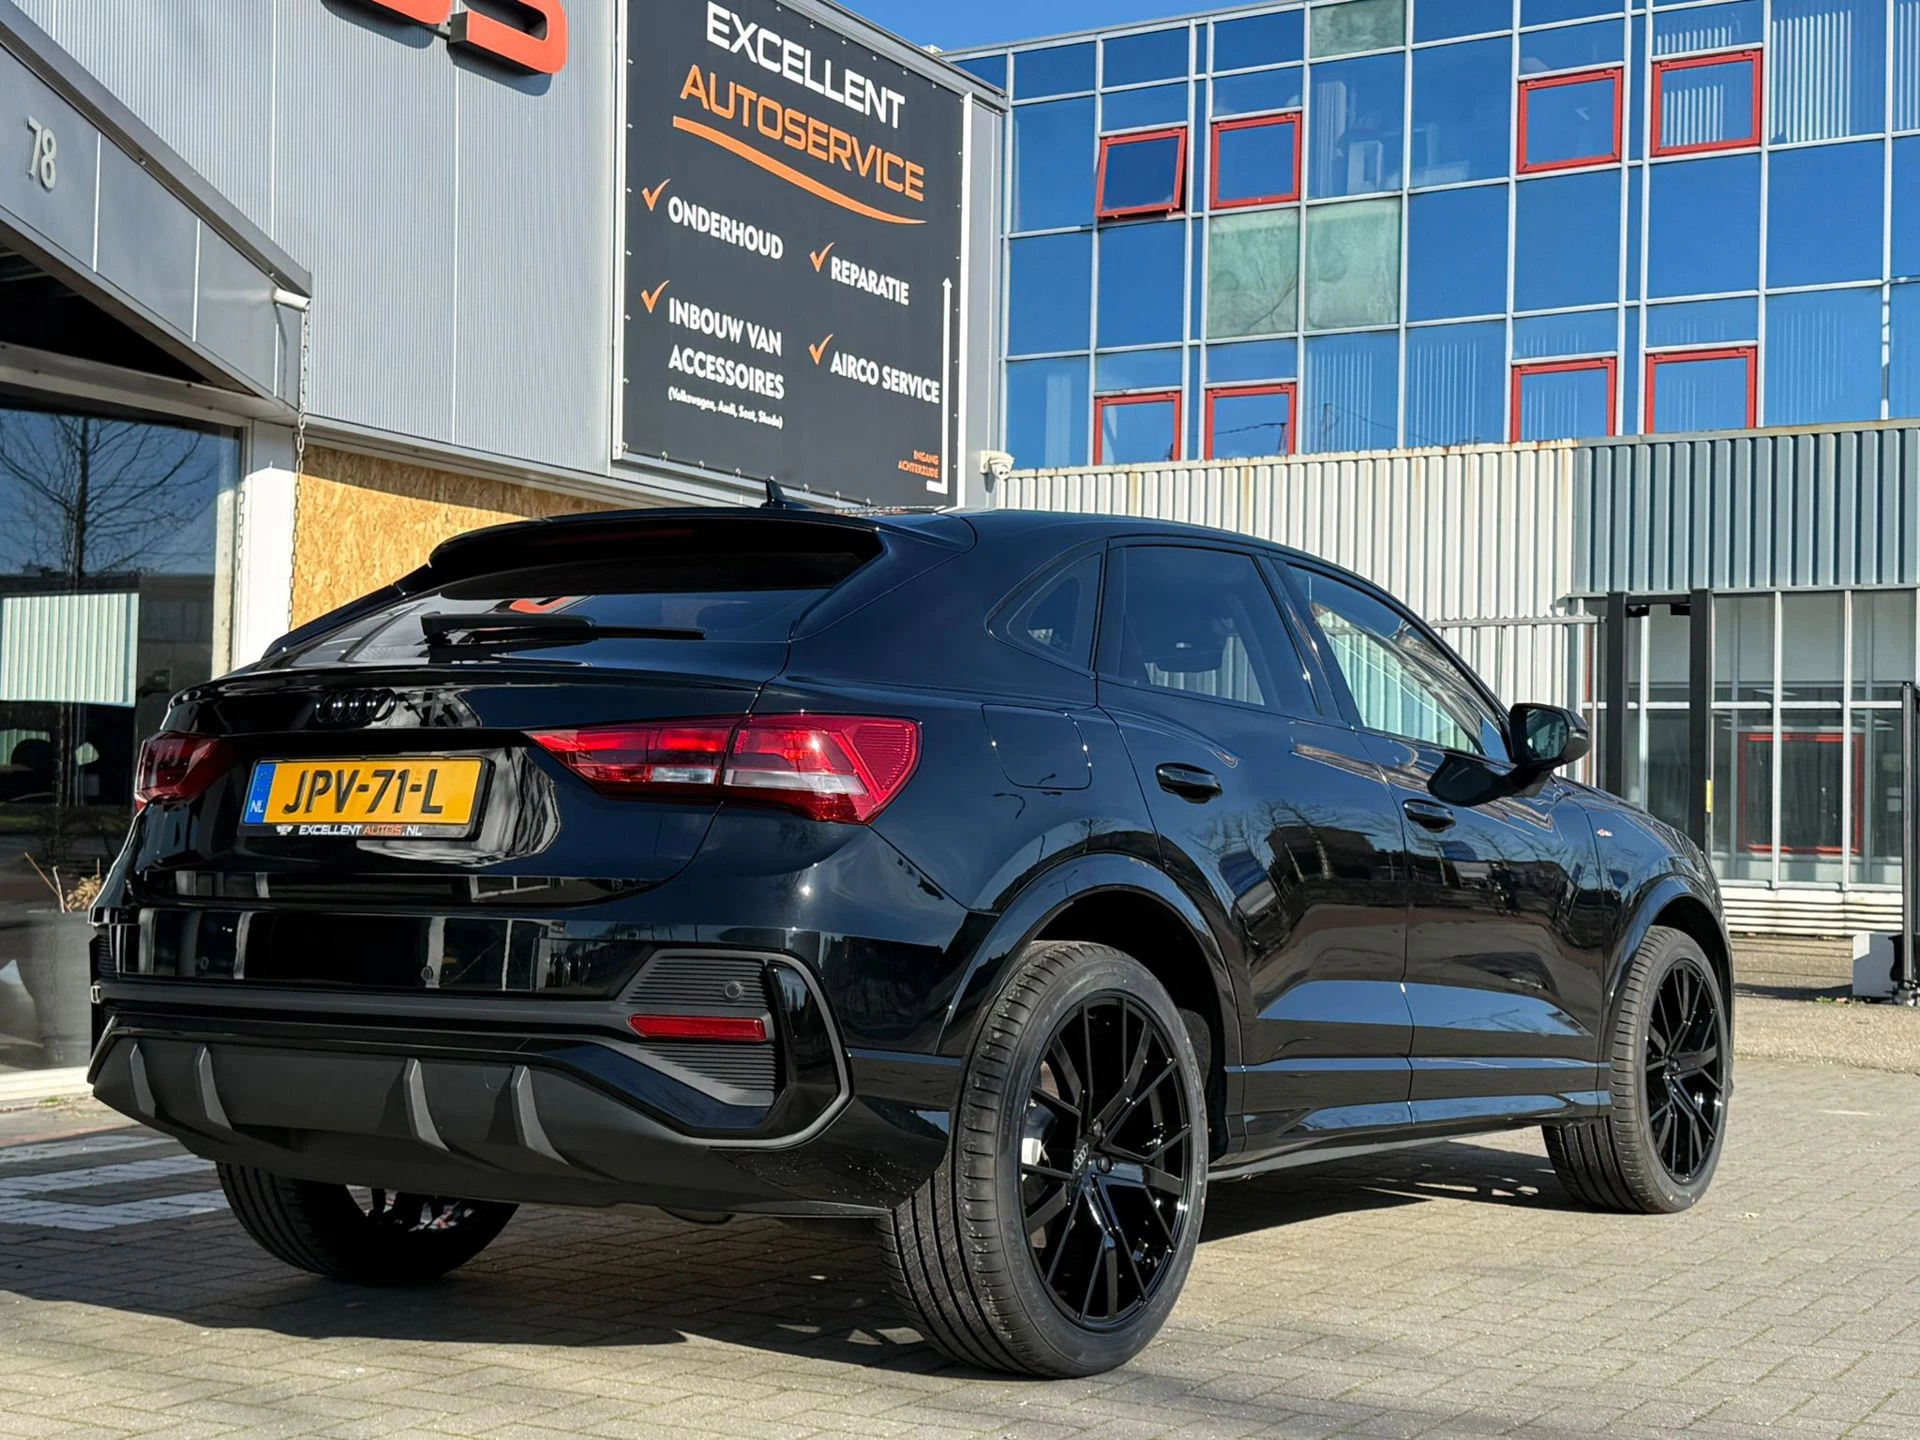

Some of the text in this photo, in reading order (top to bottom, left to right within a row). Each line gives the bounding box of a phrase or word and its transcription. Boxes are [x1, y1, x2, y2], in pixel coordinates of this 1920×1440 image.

[706, 0, 906, 129] EXCELLENT
[28, 115, 57, 189] 78
[680, 64, 925, 202] AUTOSERVICE
[667, 195, 784, 260] ONDERHOUD
[830, 255, 910, 306] REPARATIE
[668, 297, 782, 357] INBOUW VAN
[667, 344, 785, 400] ACCESSOIRES
[829, 350, 940, 404] AIRCO SERVICE
[250, 768, 444, 815] NL JPV-71-L
